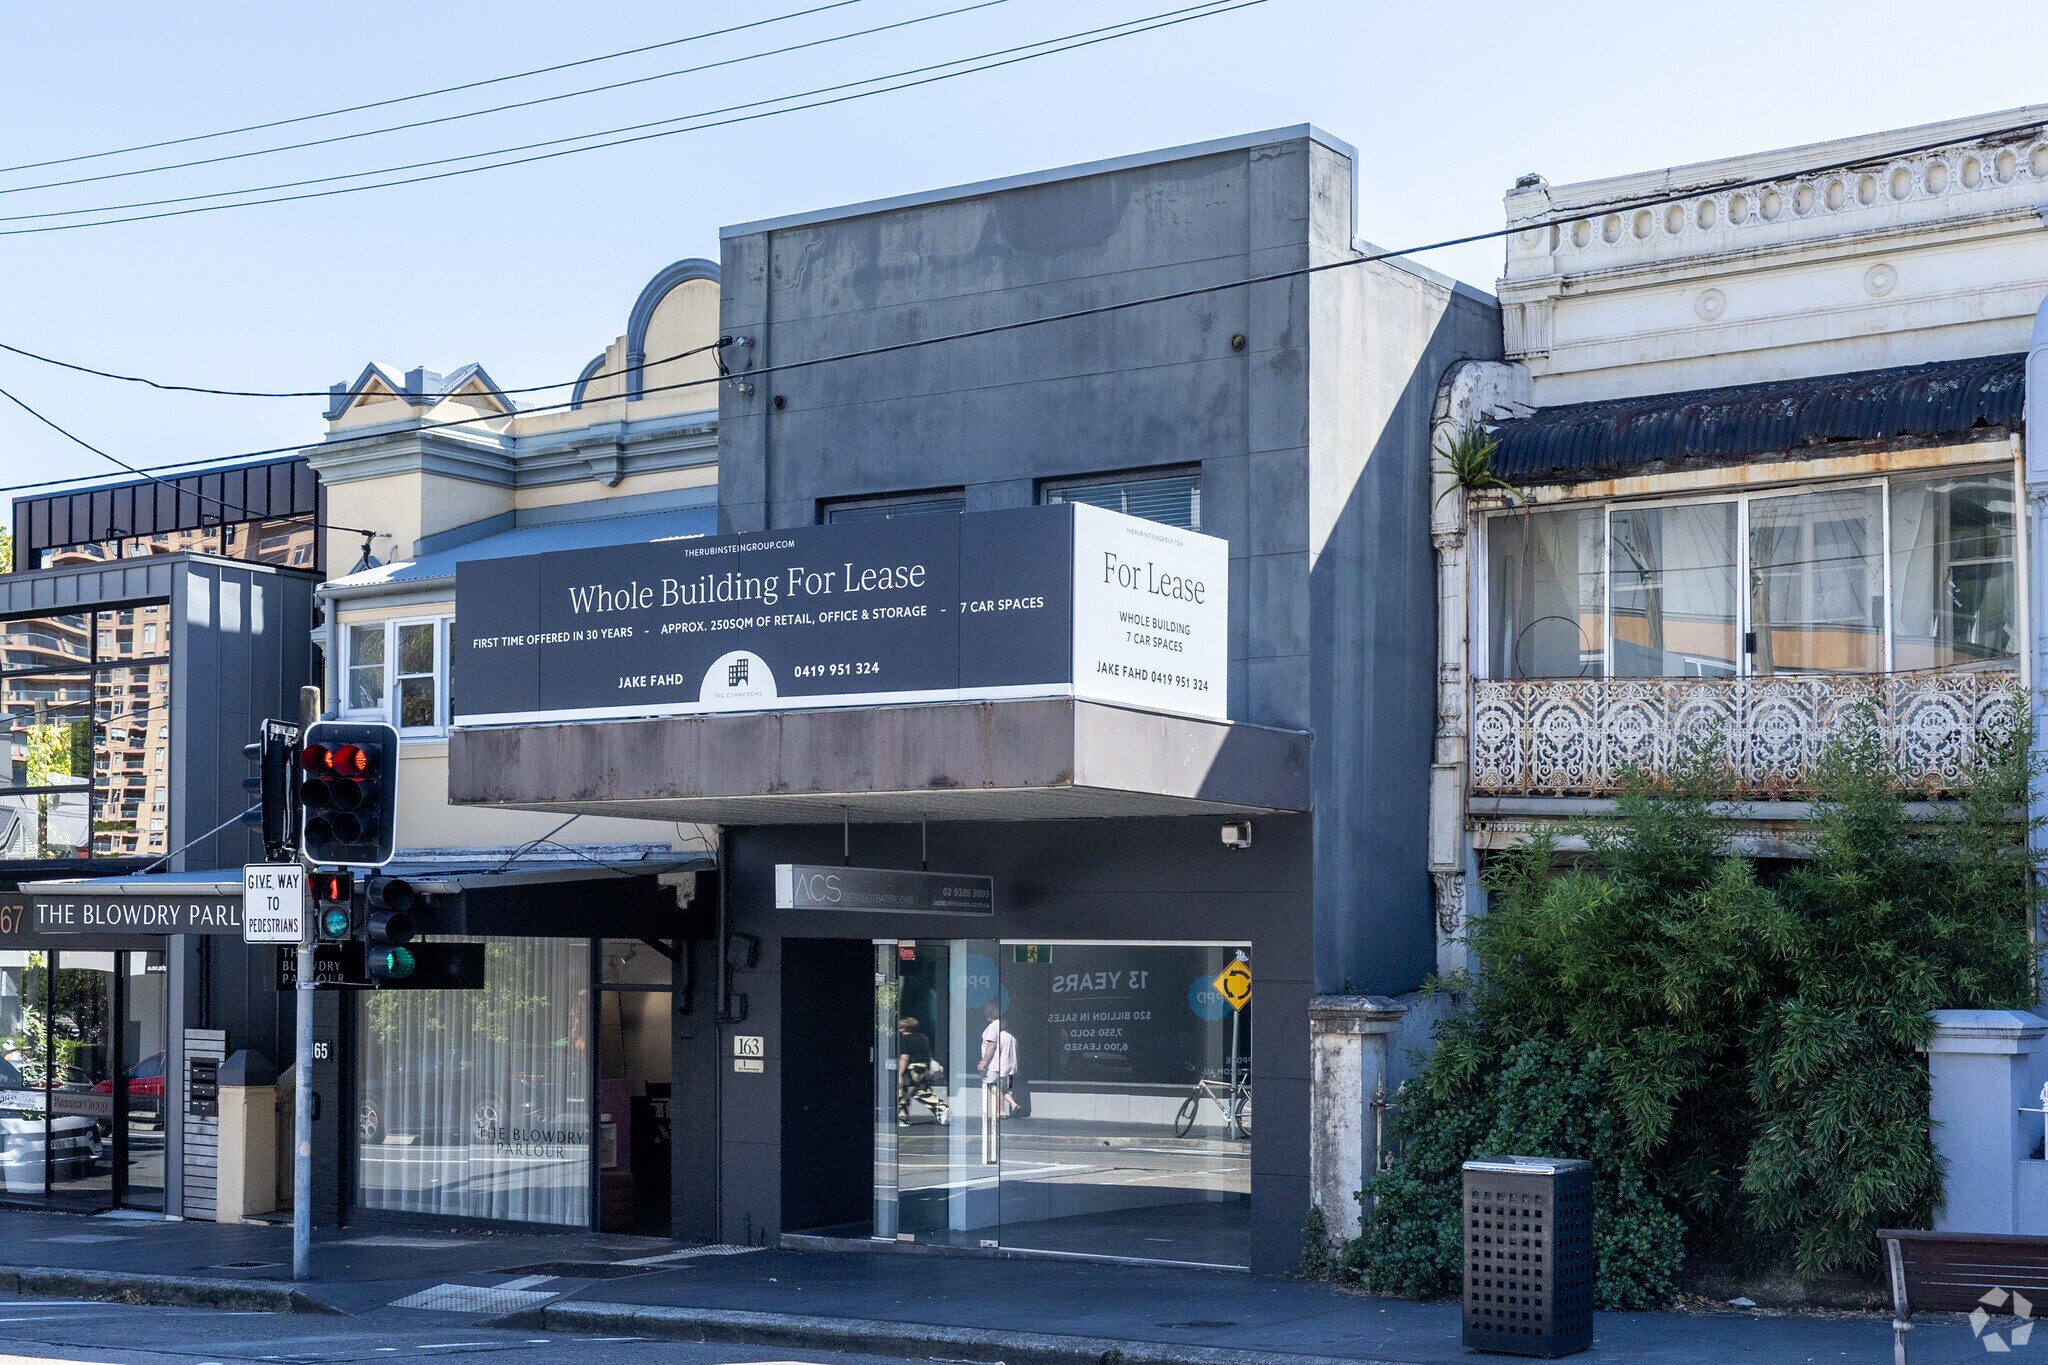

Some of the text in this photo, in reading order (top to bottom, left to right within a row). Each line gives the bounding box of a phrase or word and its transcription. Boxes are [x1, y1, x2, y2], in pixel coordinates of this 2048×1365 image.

[684, 540, 795, 558] THERUBINSTEINGROUP.COM
[1104, 551, 1205, 604] For Lease
[569, 562, 926, 614] Whole Building For Lease
[473, 637, 499, 649] FIRST
[501, 635, 524, 647] TIME
[527, 632, 570, 645] OFFERED
[573, 630, 583, 641] IN
[586, 630, 598, 640] 30
[601, 626, 633, 639] YEARS
[661, 621, 707, 634] APPROX.
[710, 616, 753, 631] 250SQM
[756, 615, 771, 627] OF
[774, 611, 815, 626] RETAIL,
[818, 609, 858, 623] OFFICE
[861, 609, 869, 620] &
[872, 605, 927, 619] STORAGE
[960, 602, 967, 613] 7
[970, 600, 994, 613] CAR
[998, 596, 1044, 611] SPACES
[1119, 611, 1191, 636] WHOLE BUILDING
[1126, 632, 1183, 652] 7 CAR SPACES
[794, 662, 880, 678] 0419 951 324
[1097, 661, 1209, 692] JAKE FAHD 0419 951 324
[618, 673, 684, 689] JAKE FAHD
[247, 874, 299, 889] GIVE WAY
[793, 873, 842, 902] ACS
[876, 893, 914, 905] BATHROOMS
[942, 887, 952, 897] 02
[953, 887, 971, 898] 9386
[267, 896, 280, 911] TO
[36, 904, 244, 926] THE BLOWDRY PARL
[249, 918, 299, 933] PEDESTRIANS
[738, 1038, 760, 1055] 163
[478, 1126, 585, 1145] THE BLOWDRY
[497, 1142, 565, 1158] PARLOUR
